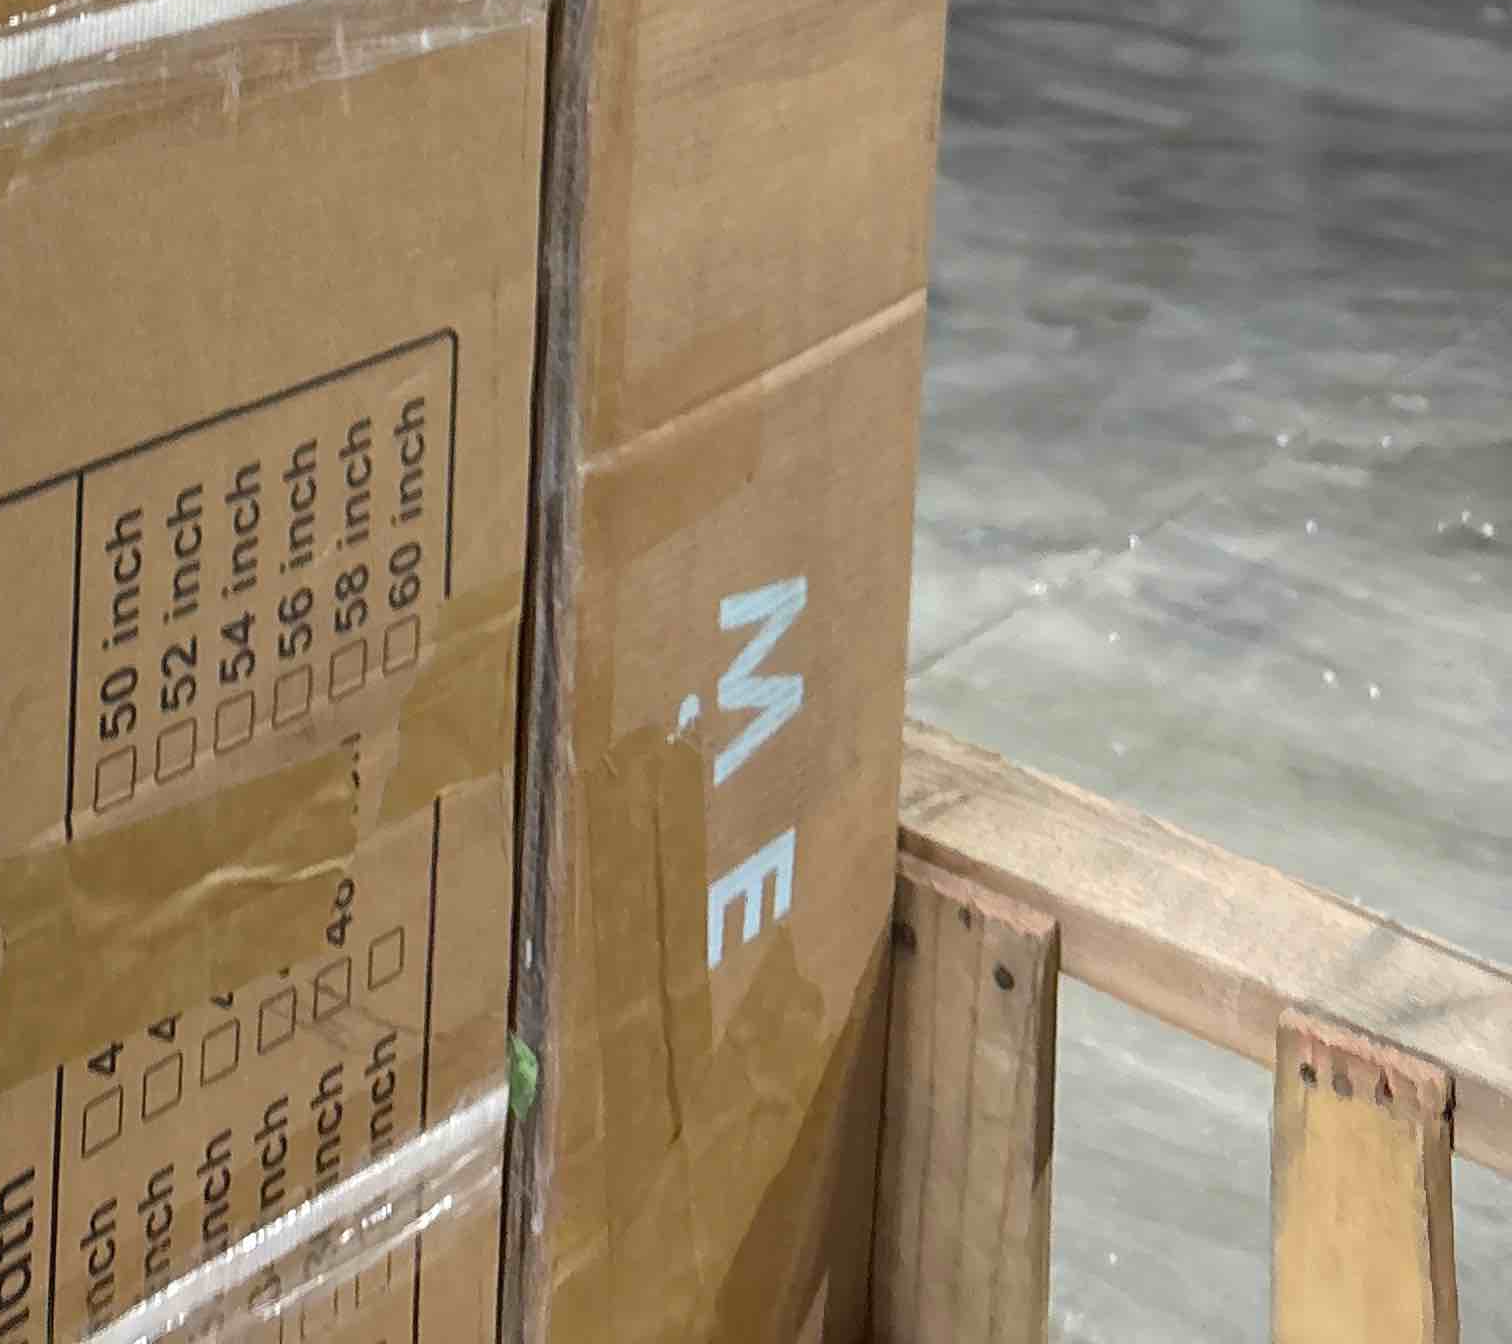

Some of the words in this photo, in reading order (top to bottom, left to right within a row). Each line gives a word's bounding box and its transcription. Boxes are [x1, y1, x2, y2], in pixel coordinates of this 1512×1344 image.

[280, 436, 318, 576] inch
[336, 414, 374, 553] inch
[391, 394, 426, 525] inch
[102, 507, 144, 652] inch
[163, 481, 205, 627] inch
[222, 459, 262, 598] inch
[388, 540, 422, 611] 60
[219, 611, 256, 685] 54
[278, 587, 314, 660] 56
[334, 564, 370, 635] 58
[99, 664, 138, 741] 50
[160, 634, 197, 713] 52
